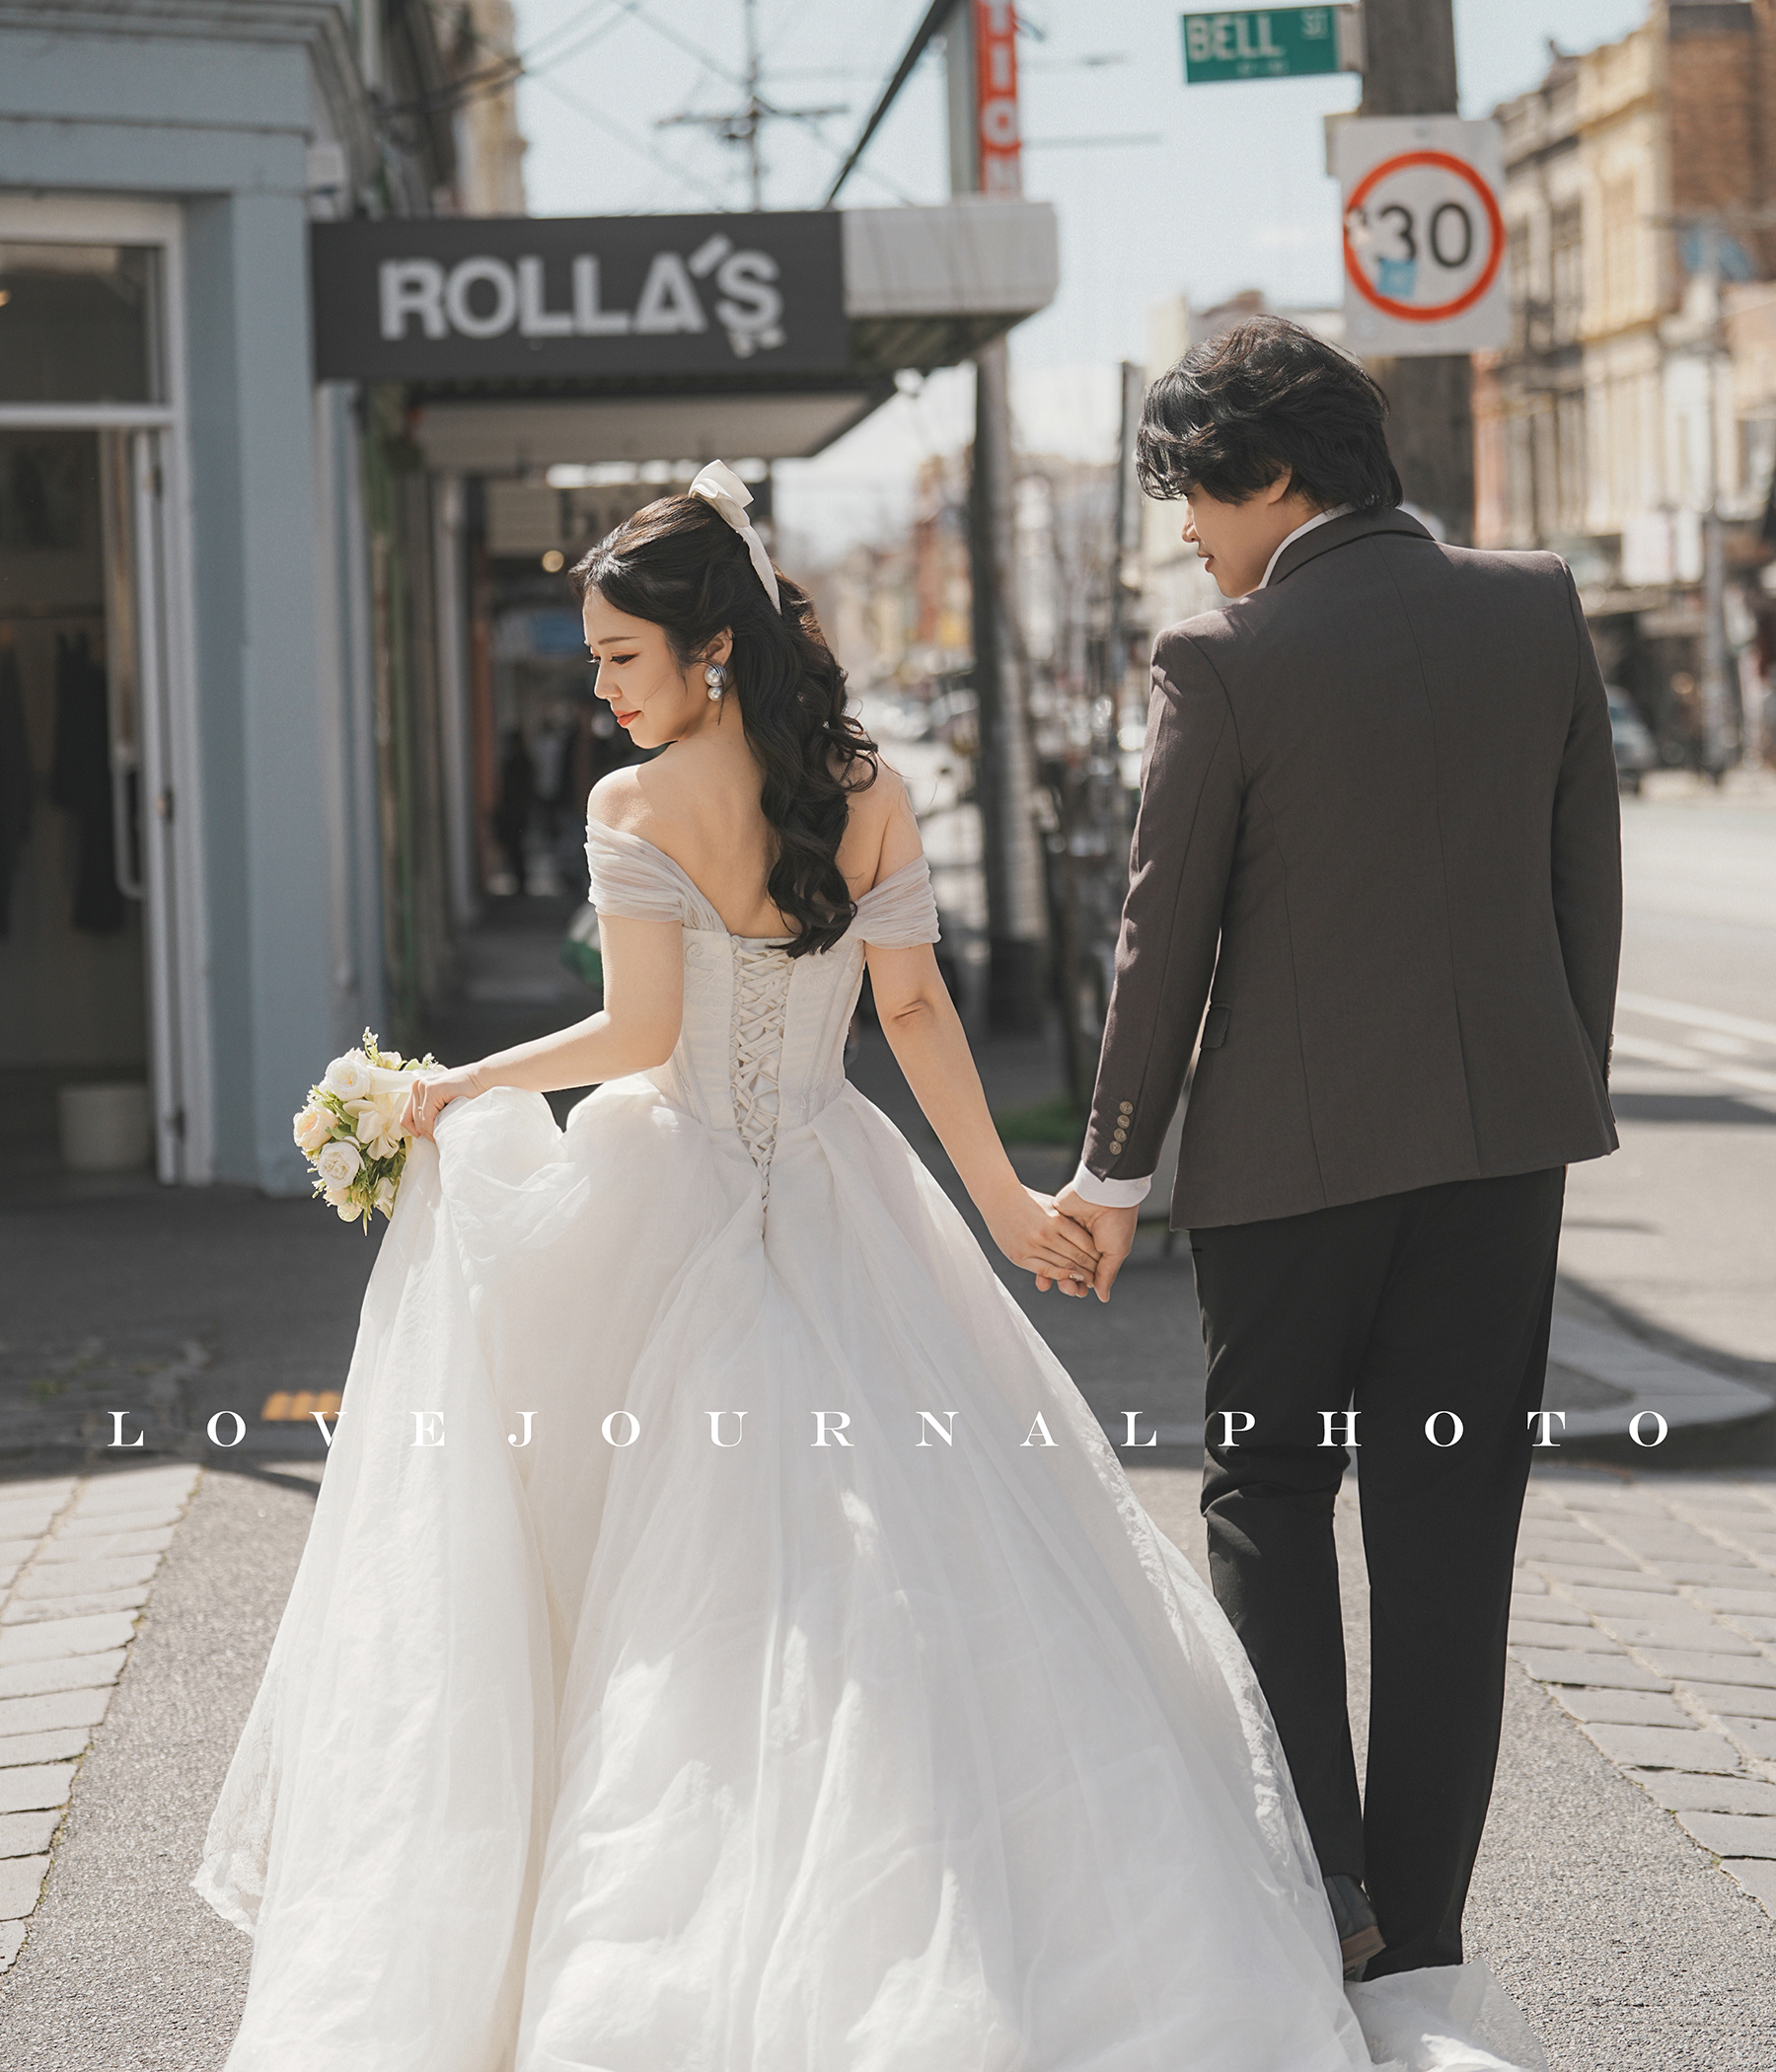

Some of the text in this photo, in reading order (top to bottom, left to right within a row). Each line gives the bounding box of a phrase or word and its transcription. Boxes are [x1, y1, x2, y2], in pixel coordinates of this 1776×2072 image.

[1186, 15, 1285, 61] BELL
[1377, 200, 1473, 269] 30
[379, 233, 785, 341] ROLLA'S
